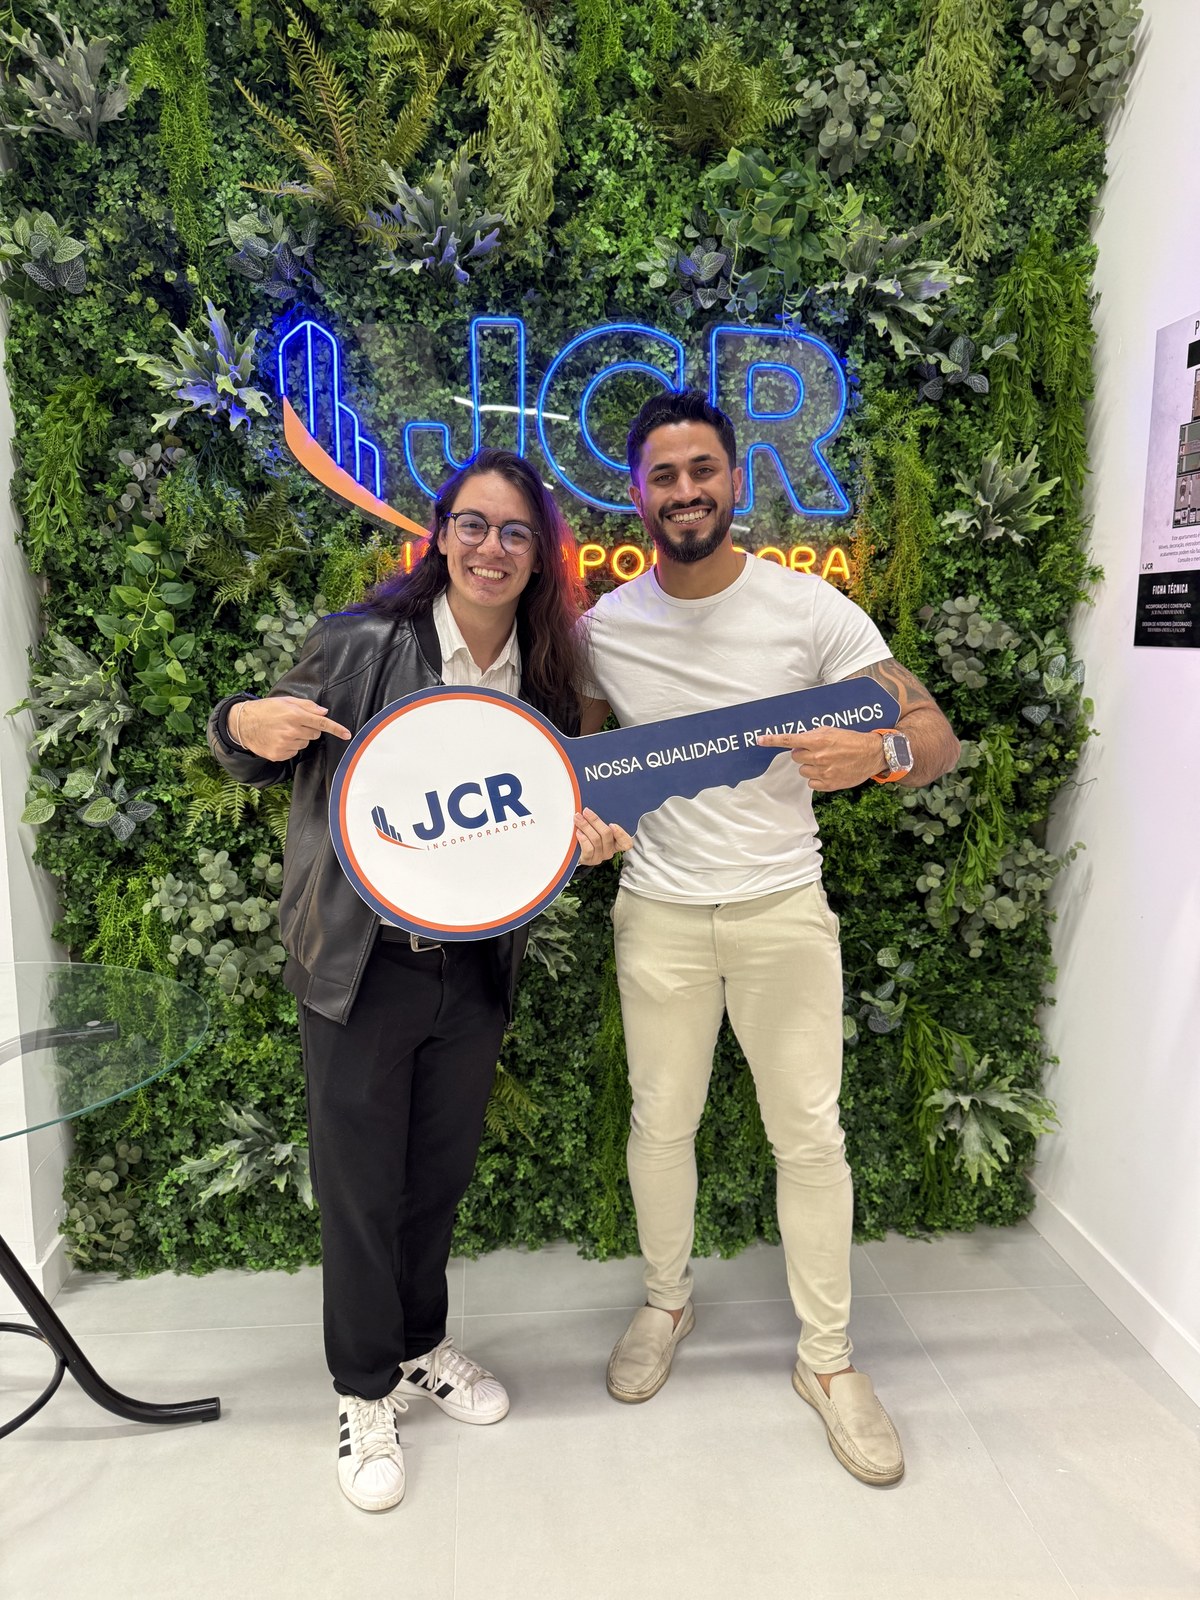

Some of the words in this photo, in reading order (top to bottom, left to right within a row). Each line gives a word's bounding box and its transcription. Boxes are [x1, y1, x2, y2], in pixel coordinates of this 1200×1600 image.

[403, 317, 851, 515] JCR
[1152, 585, 1166, 595] FICHA
[1168, 583, 1188, 594] TÉCNICA
[584, 756, 643, 782] NOSSA
[646, 734, 740, 768] QUALIDADE
[811, 703, 884, 730] SONHOS
[412, 772, 532, 841] JCR
[426, 818, 536, 851] INCORPORADORA
